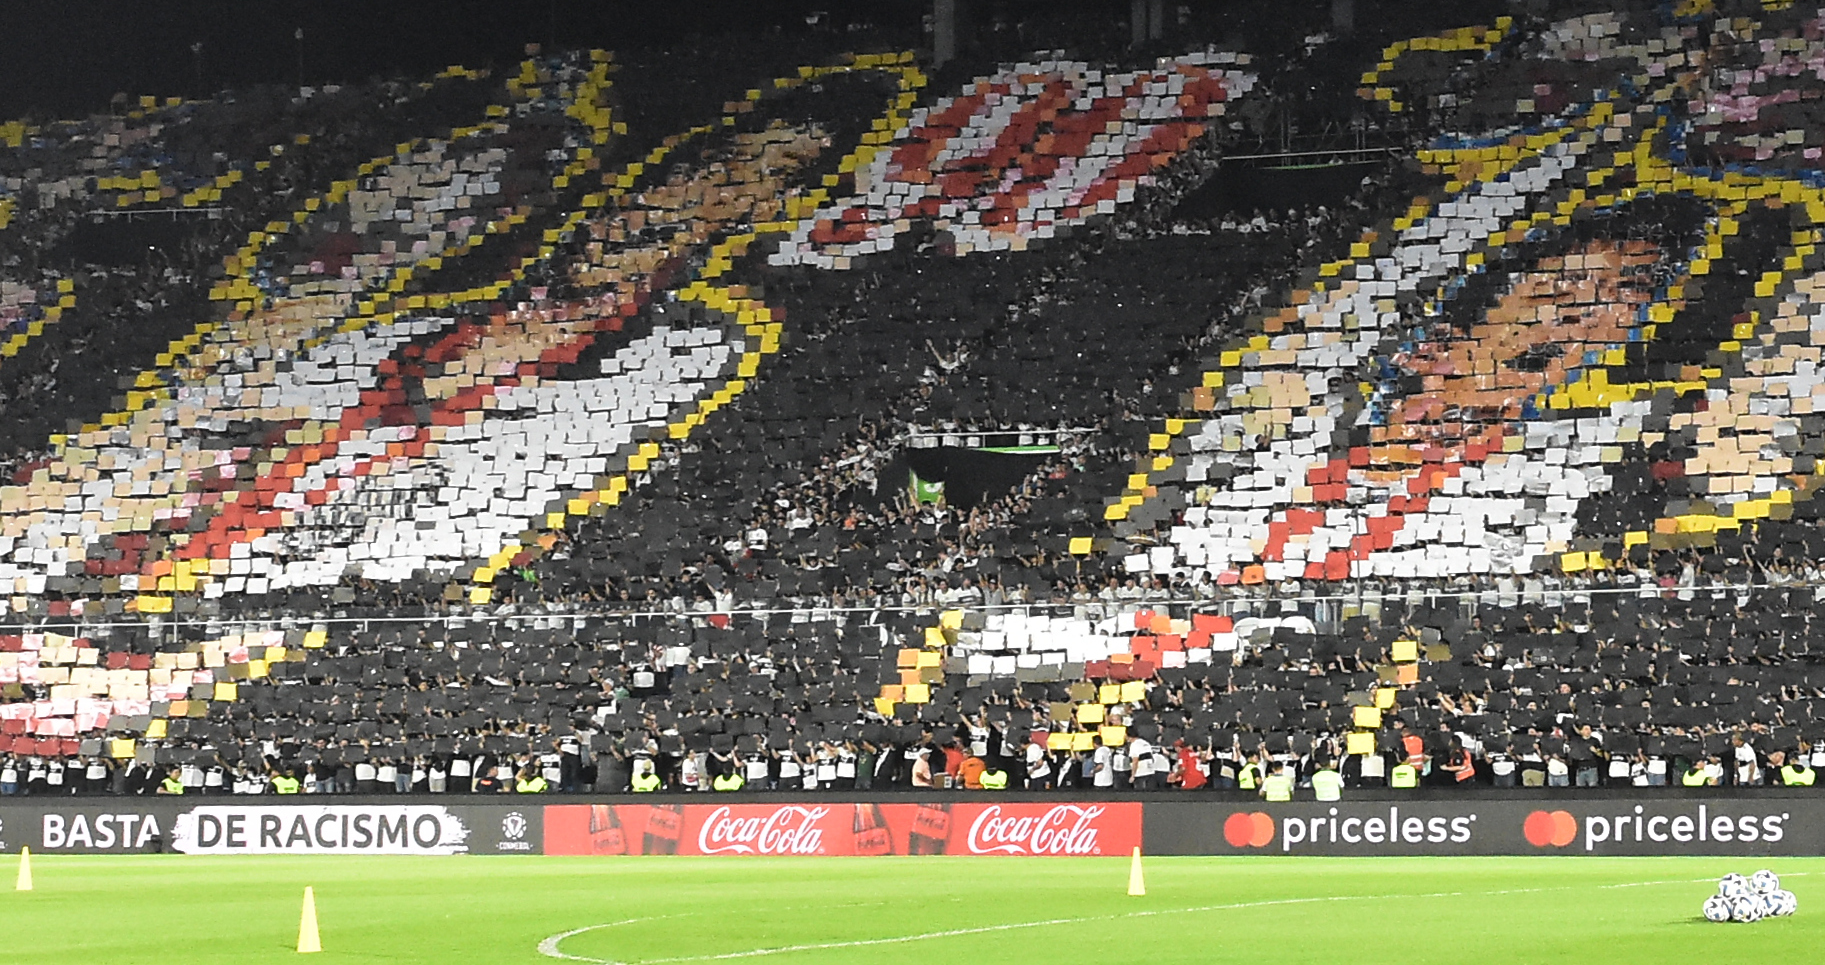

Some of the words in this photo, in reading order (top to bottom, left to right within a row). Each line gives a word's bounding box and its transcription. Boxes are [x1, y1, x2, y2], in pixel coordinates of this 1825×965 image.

[43, 814, 160, 848] BASTA
[198, 814, 247, 848] DE
[260, 813, 441, 849] RACISMO
[698, 806, 830, 854] Coca-Cola
[967, 804, 1106, 855] Coca-Cola
[1283, 807, 1472, 852] priceless
[1586, 804, 1784, 851] priceless
